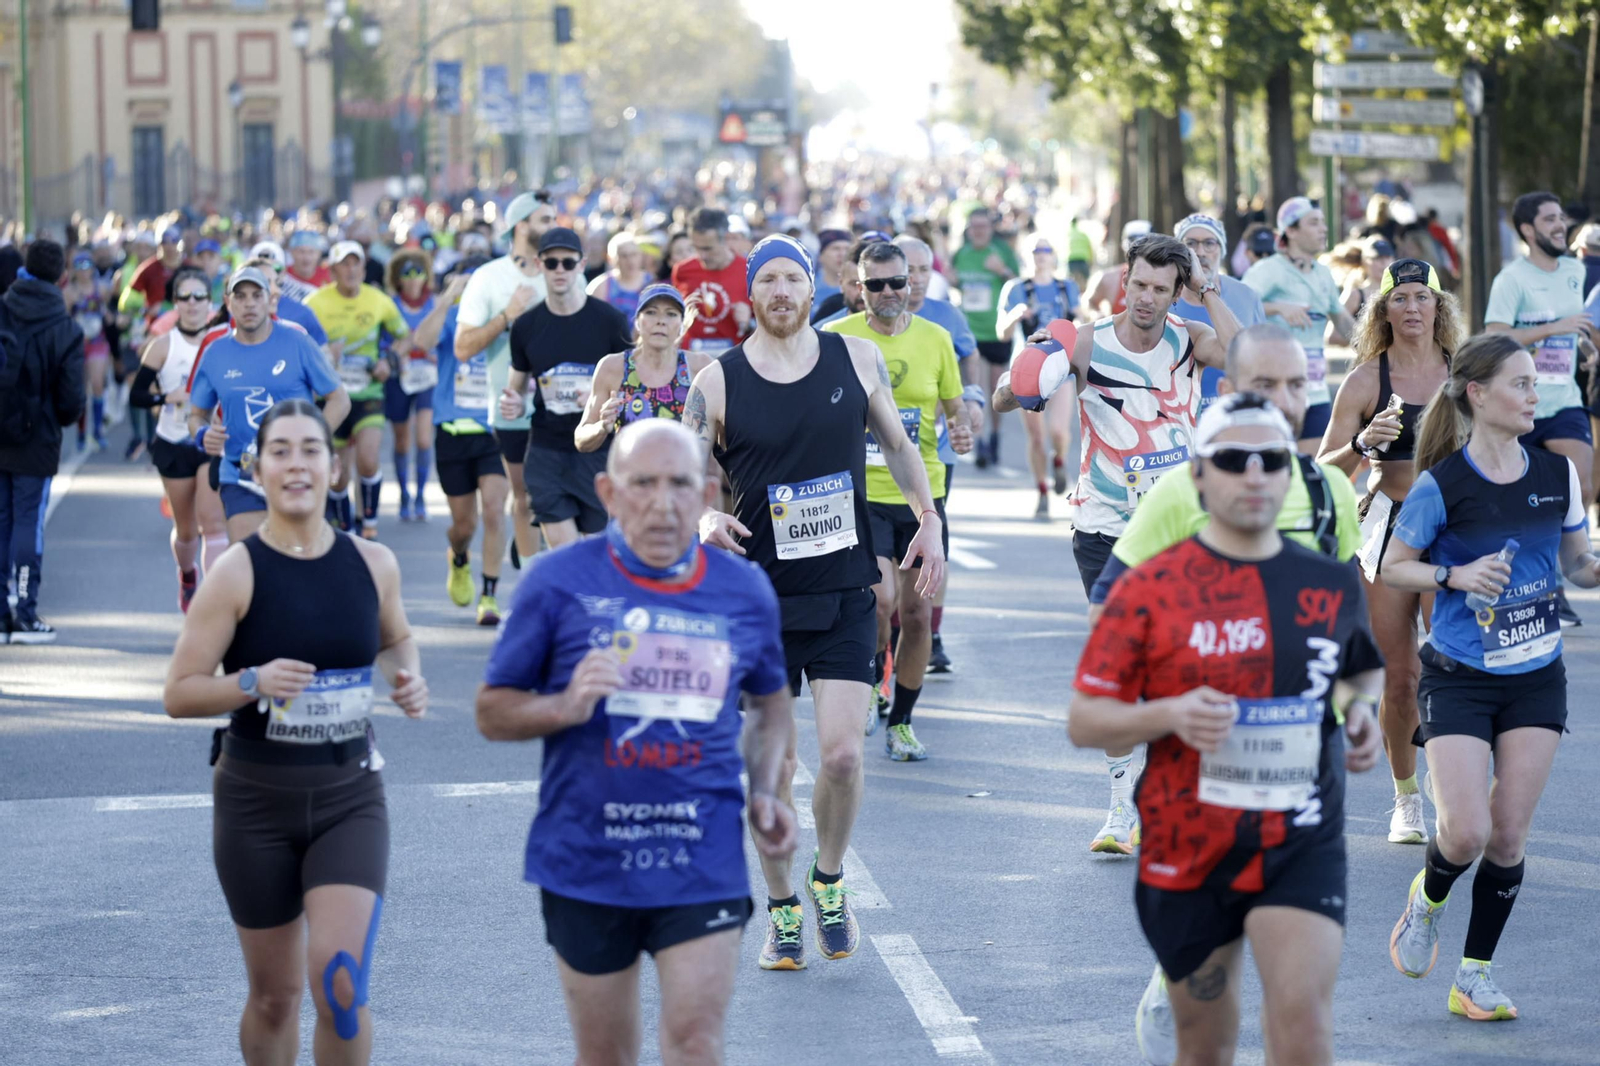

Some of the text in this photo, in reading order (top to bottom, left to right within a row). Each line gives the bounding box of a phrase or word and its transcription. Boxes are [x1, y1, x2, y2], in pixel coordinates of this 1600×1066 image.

[1149, 450, 1183, 466] ZURICH
[798, 478, 843, 496] ZURICH
[800, 504, 829, 518] 11812
[789, 515, 842, 539] GAVINO
[1505, 577, 1548, 600] ZURICH
[1295, 587, 1344, 636] SOY
[1507, 605, 1536, 624] 13936
[655, 613, 717, 635] ZURICH
[1498, 617, 1546, 647] SARAH
[1188, 617, 1266, 657] 42,195
[630, 666, 712, 692] SOTELO
[1246, 704, 1308, 723] ZURICH
[603, 799, 700, 820] SYDNEY
[604, 823, 704, 842] MARATHON
[620, 847, 692, 871] 2024
